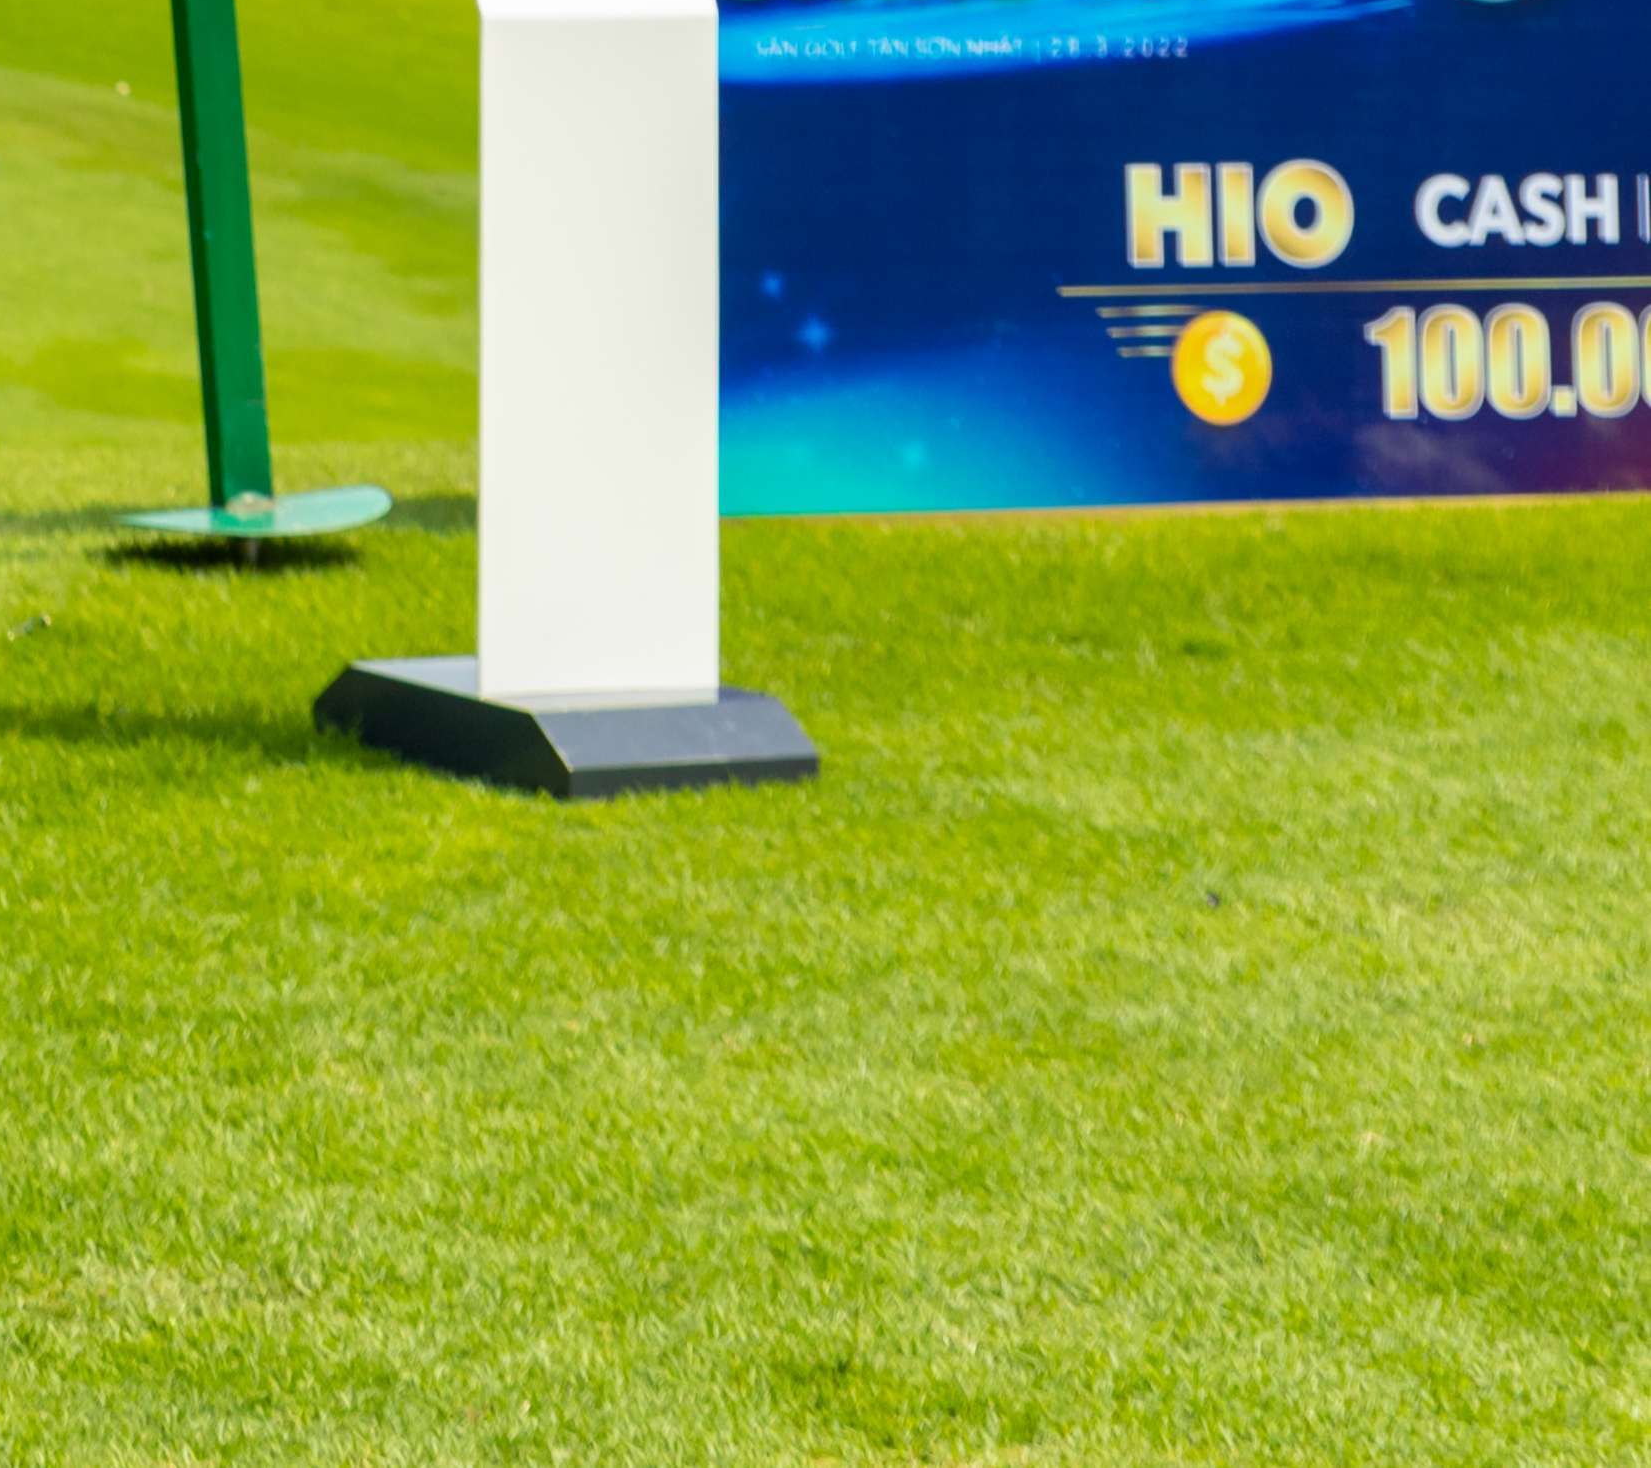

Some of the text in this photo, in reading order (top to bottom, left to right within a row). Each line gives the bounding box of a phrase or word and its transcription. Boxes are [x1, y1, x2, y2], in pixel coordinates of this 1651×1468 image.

[1124, 158, 1355, 269] HIO
[1414, 172, 1620, 248] CASH
[1366, 301, 1651, 421] 100.0
